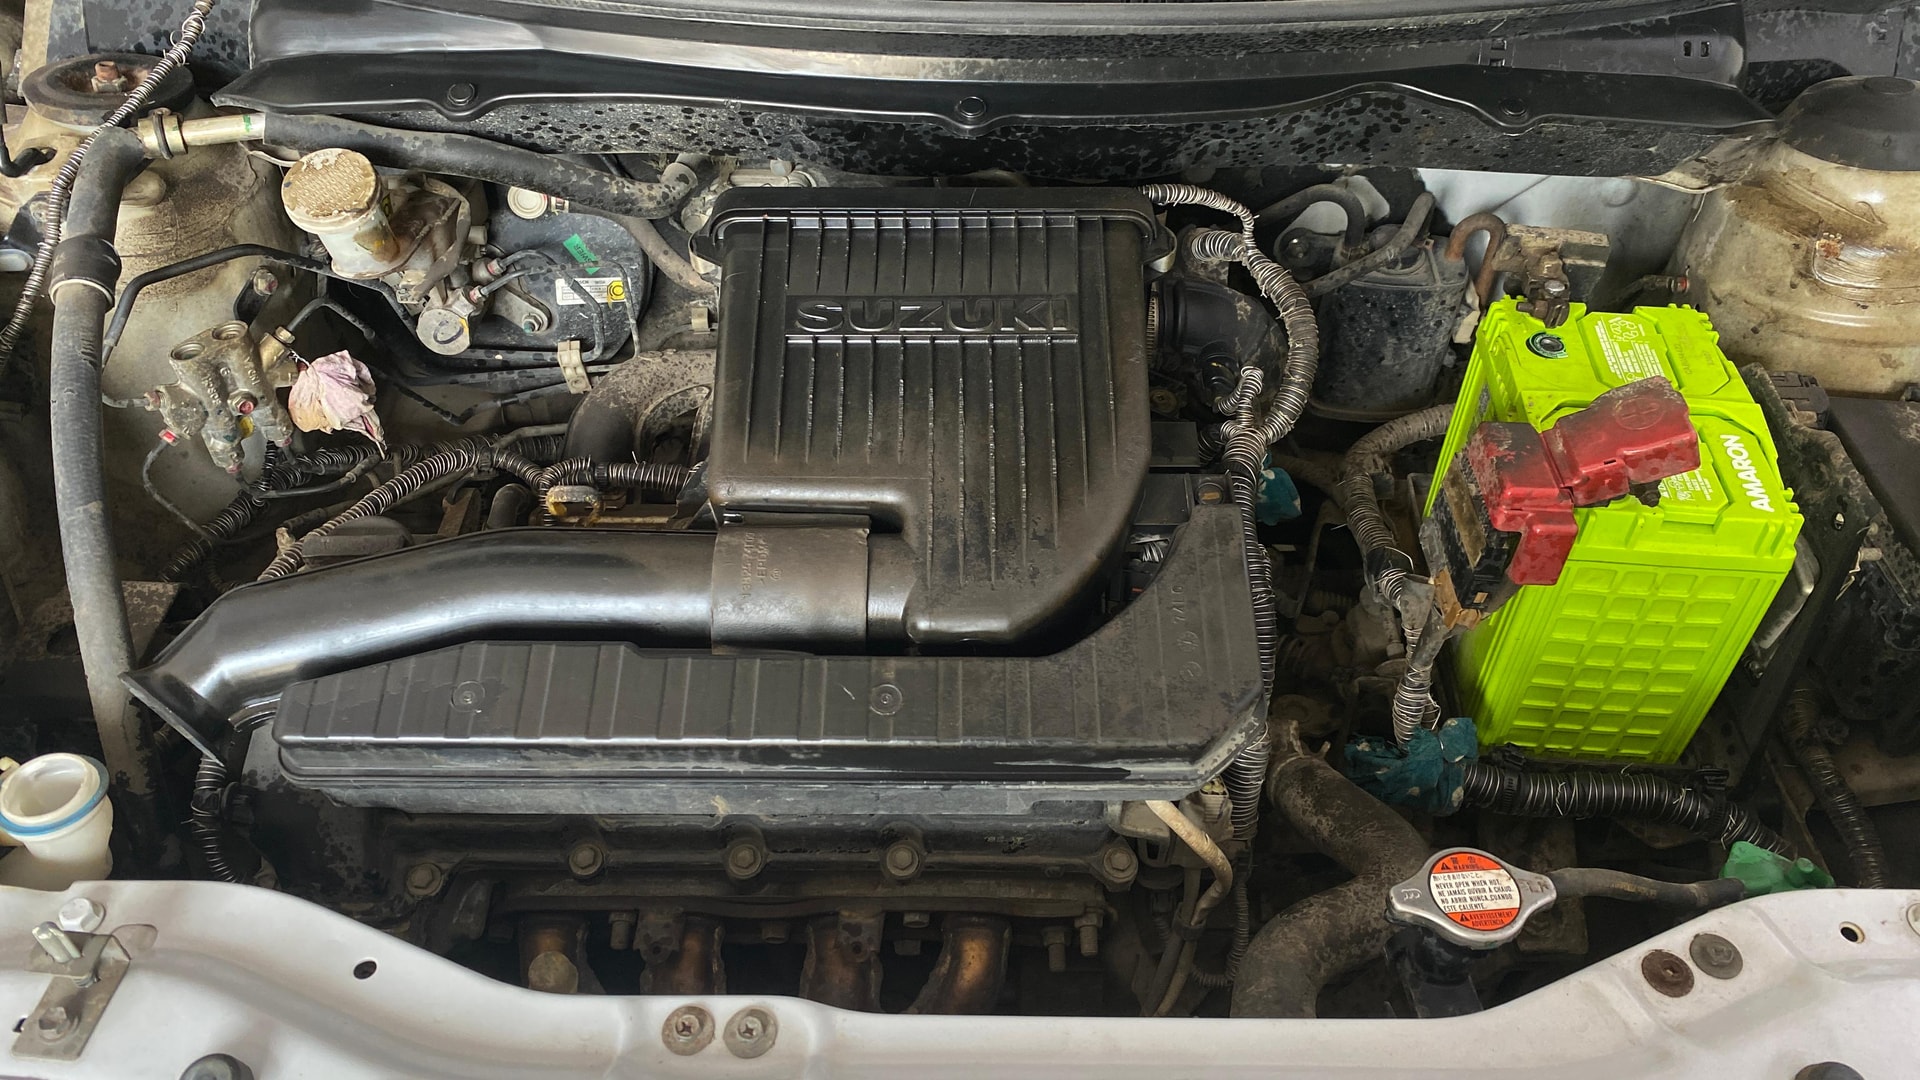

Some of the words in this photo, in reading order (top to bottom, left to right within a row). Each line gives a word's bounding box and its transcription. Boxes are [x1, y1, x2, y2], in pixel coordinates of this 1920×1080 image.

[796, 299, 1071, 333] SUZUKI
[1720, 434, 1775, 513] AMARON
[1435, 882, 1454, 890] NEVER
[1455, 881, 1470, 889] OPEN
[1471, 879, 1488, 887] WHEN
[1437, 889, 1446, 897] NE
[1447, 888, 1467, 896] JAMAIS
[1468, 887, 1487, 895] OUVRIR
[1440, 897, 1449, 905] NO
[1450, 896, 1468, 904] ABRIR
[1489, 893, 1513, 901] CUANDO
[1443, 904, 1458, 912] ESTE
